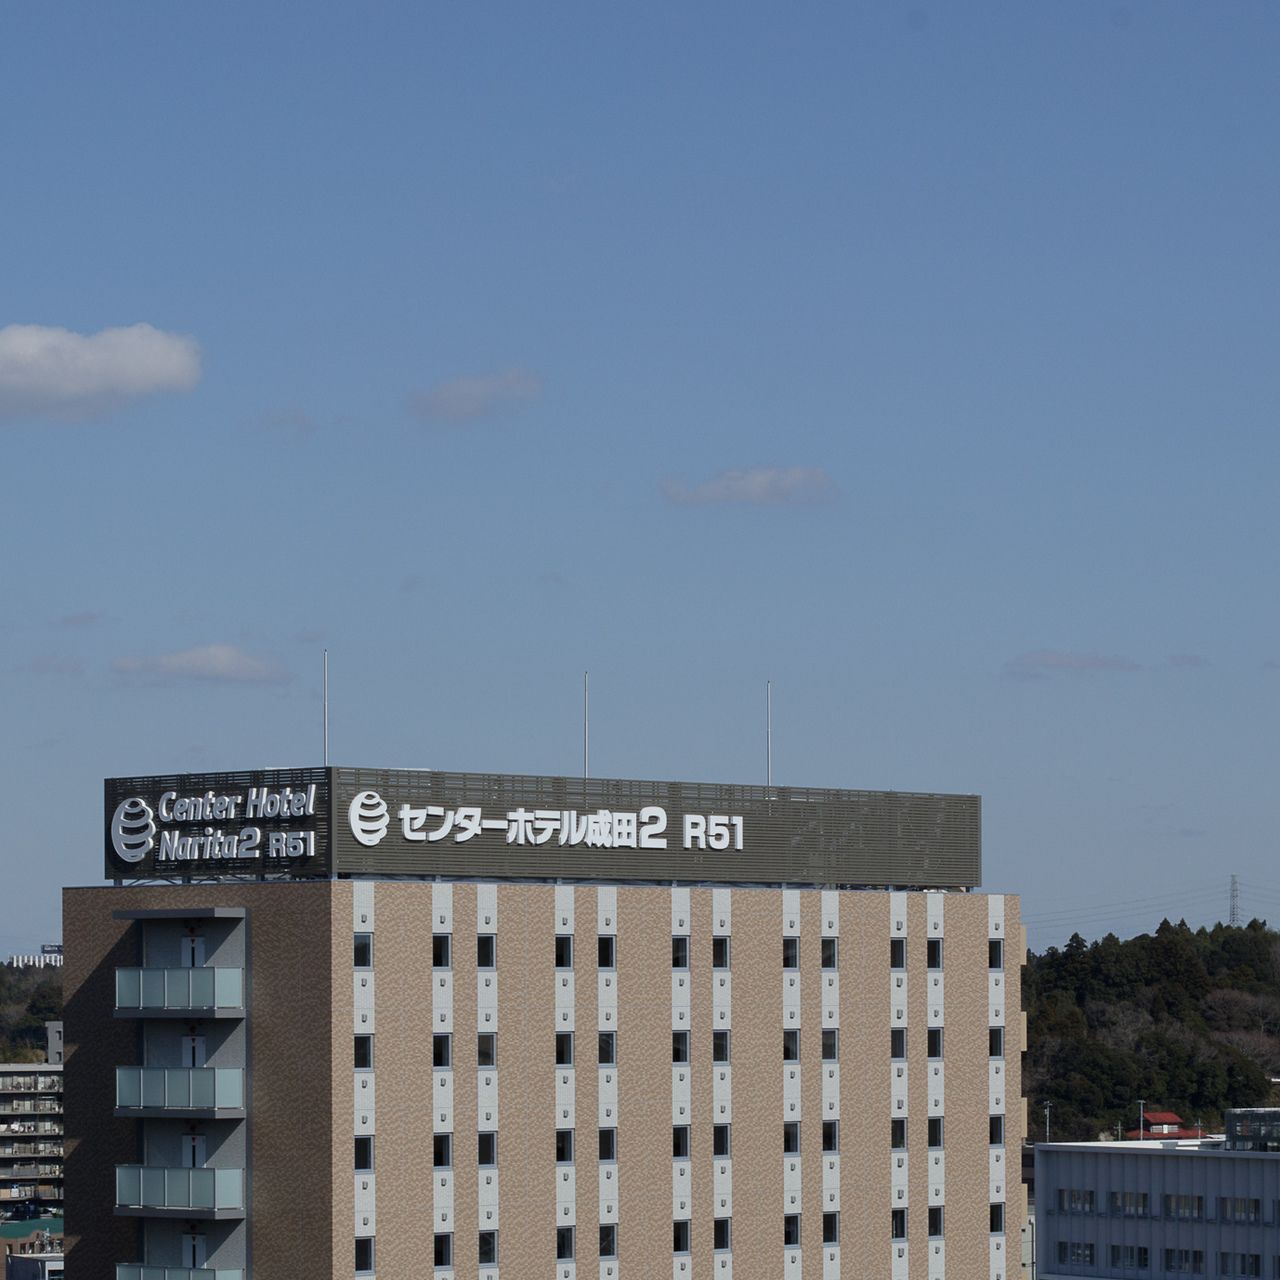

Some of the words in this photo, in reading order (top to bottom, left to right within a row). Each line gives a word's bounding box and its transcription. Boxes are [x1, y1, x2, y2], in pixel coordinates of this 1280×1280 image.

[158, 789, 241, 823] Center
[244, 785, 316, 818] Hotel
[158, 827, 261, 861] Narita2
[267, 830, 316, 858] R51
[397, 803, 668, 849] センターホテル成田2
[682, 815, 745, 850] R51
